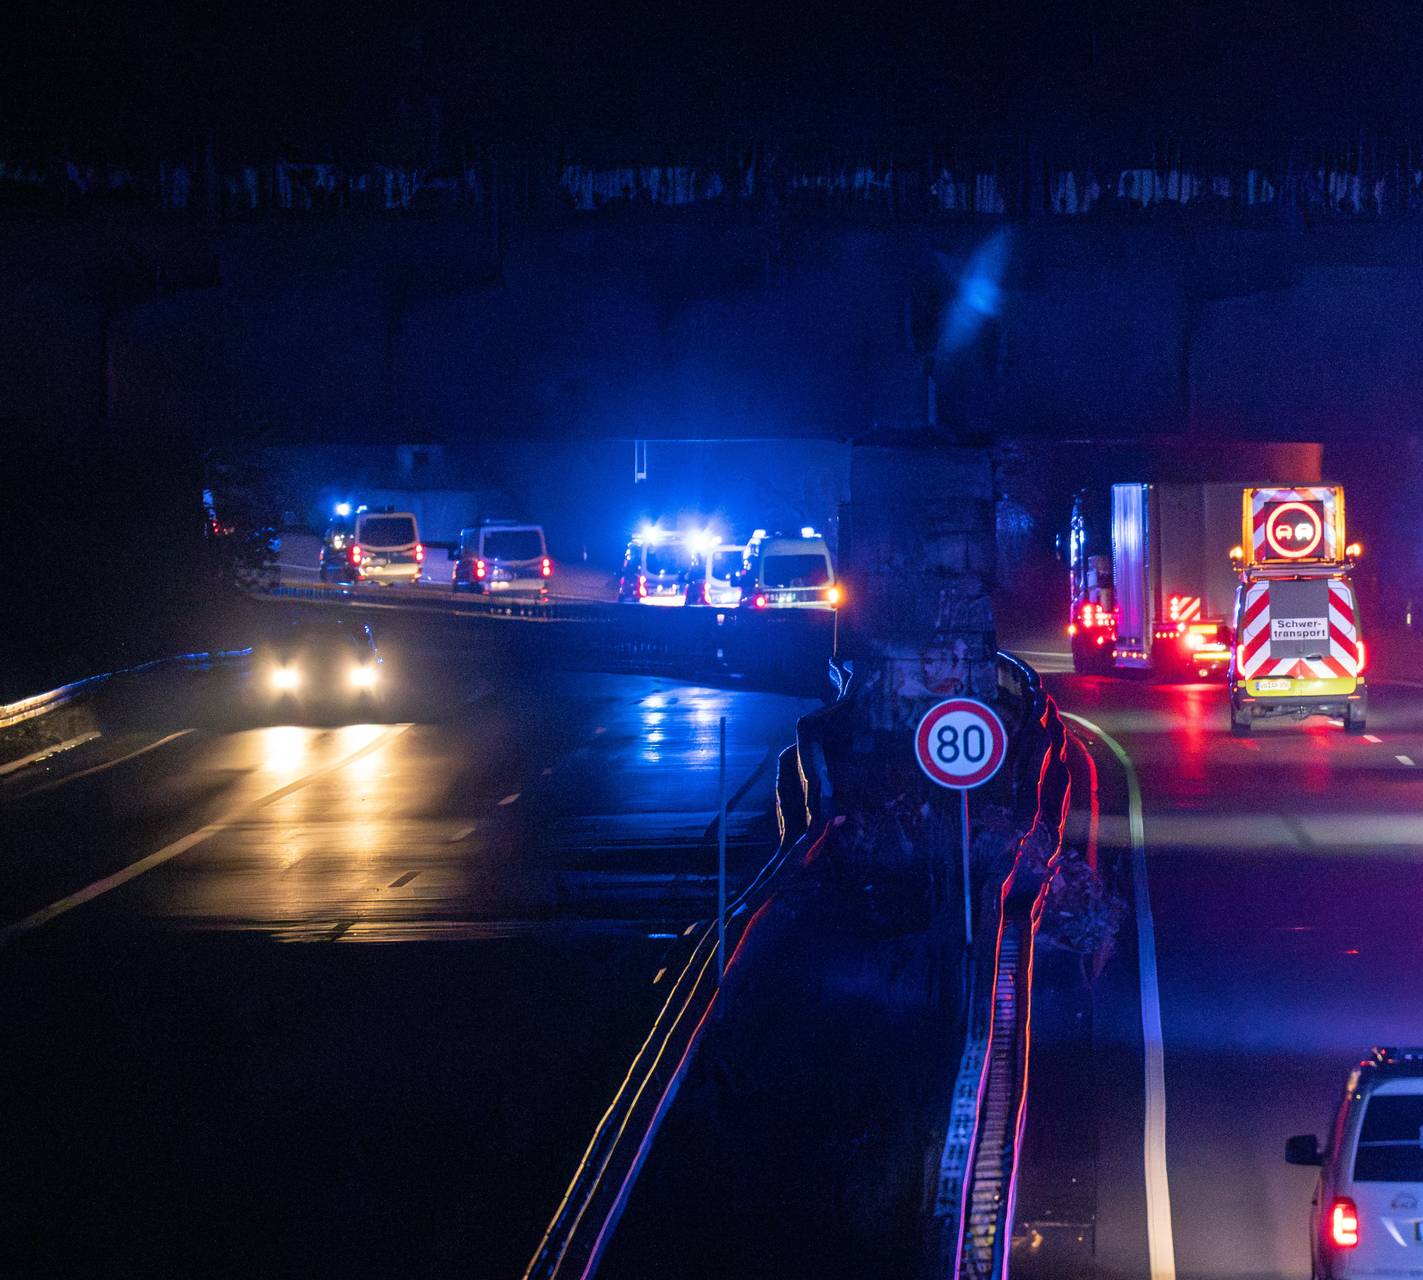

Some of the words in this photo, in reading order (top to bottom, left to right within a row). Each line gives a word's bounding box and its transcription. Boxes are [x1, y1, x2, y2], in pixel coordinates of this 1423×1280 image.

[1277, 620, 1322, 628] Schwer-
[1274, 629, 1325, 638] transport
[937, 724, 985, 764] 80
